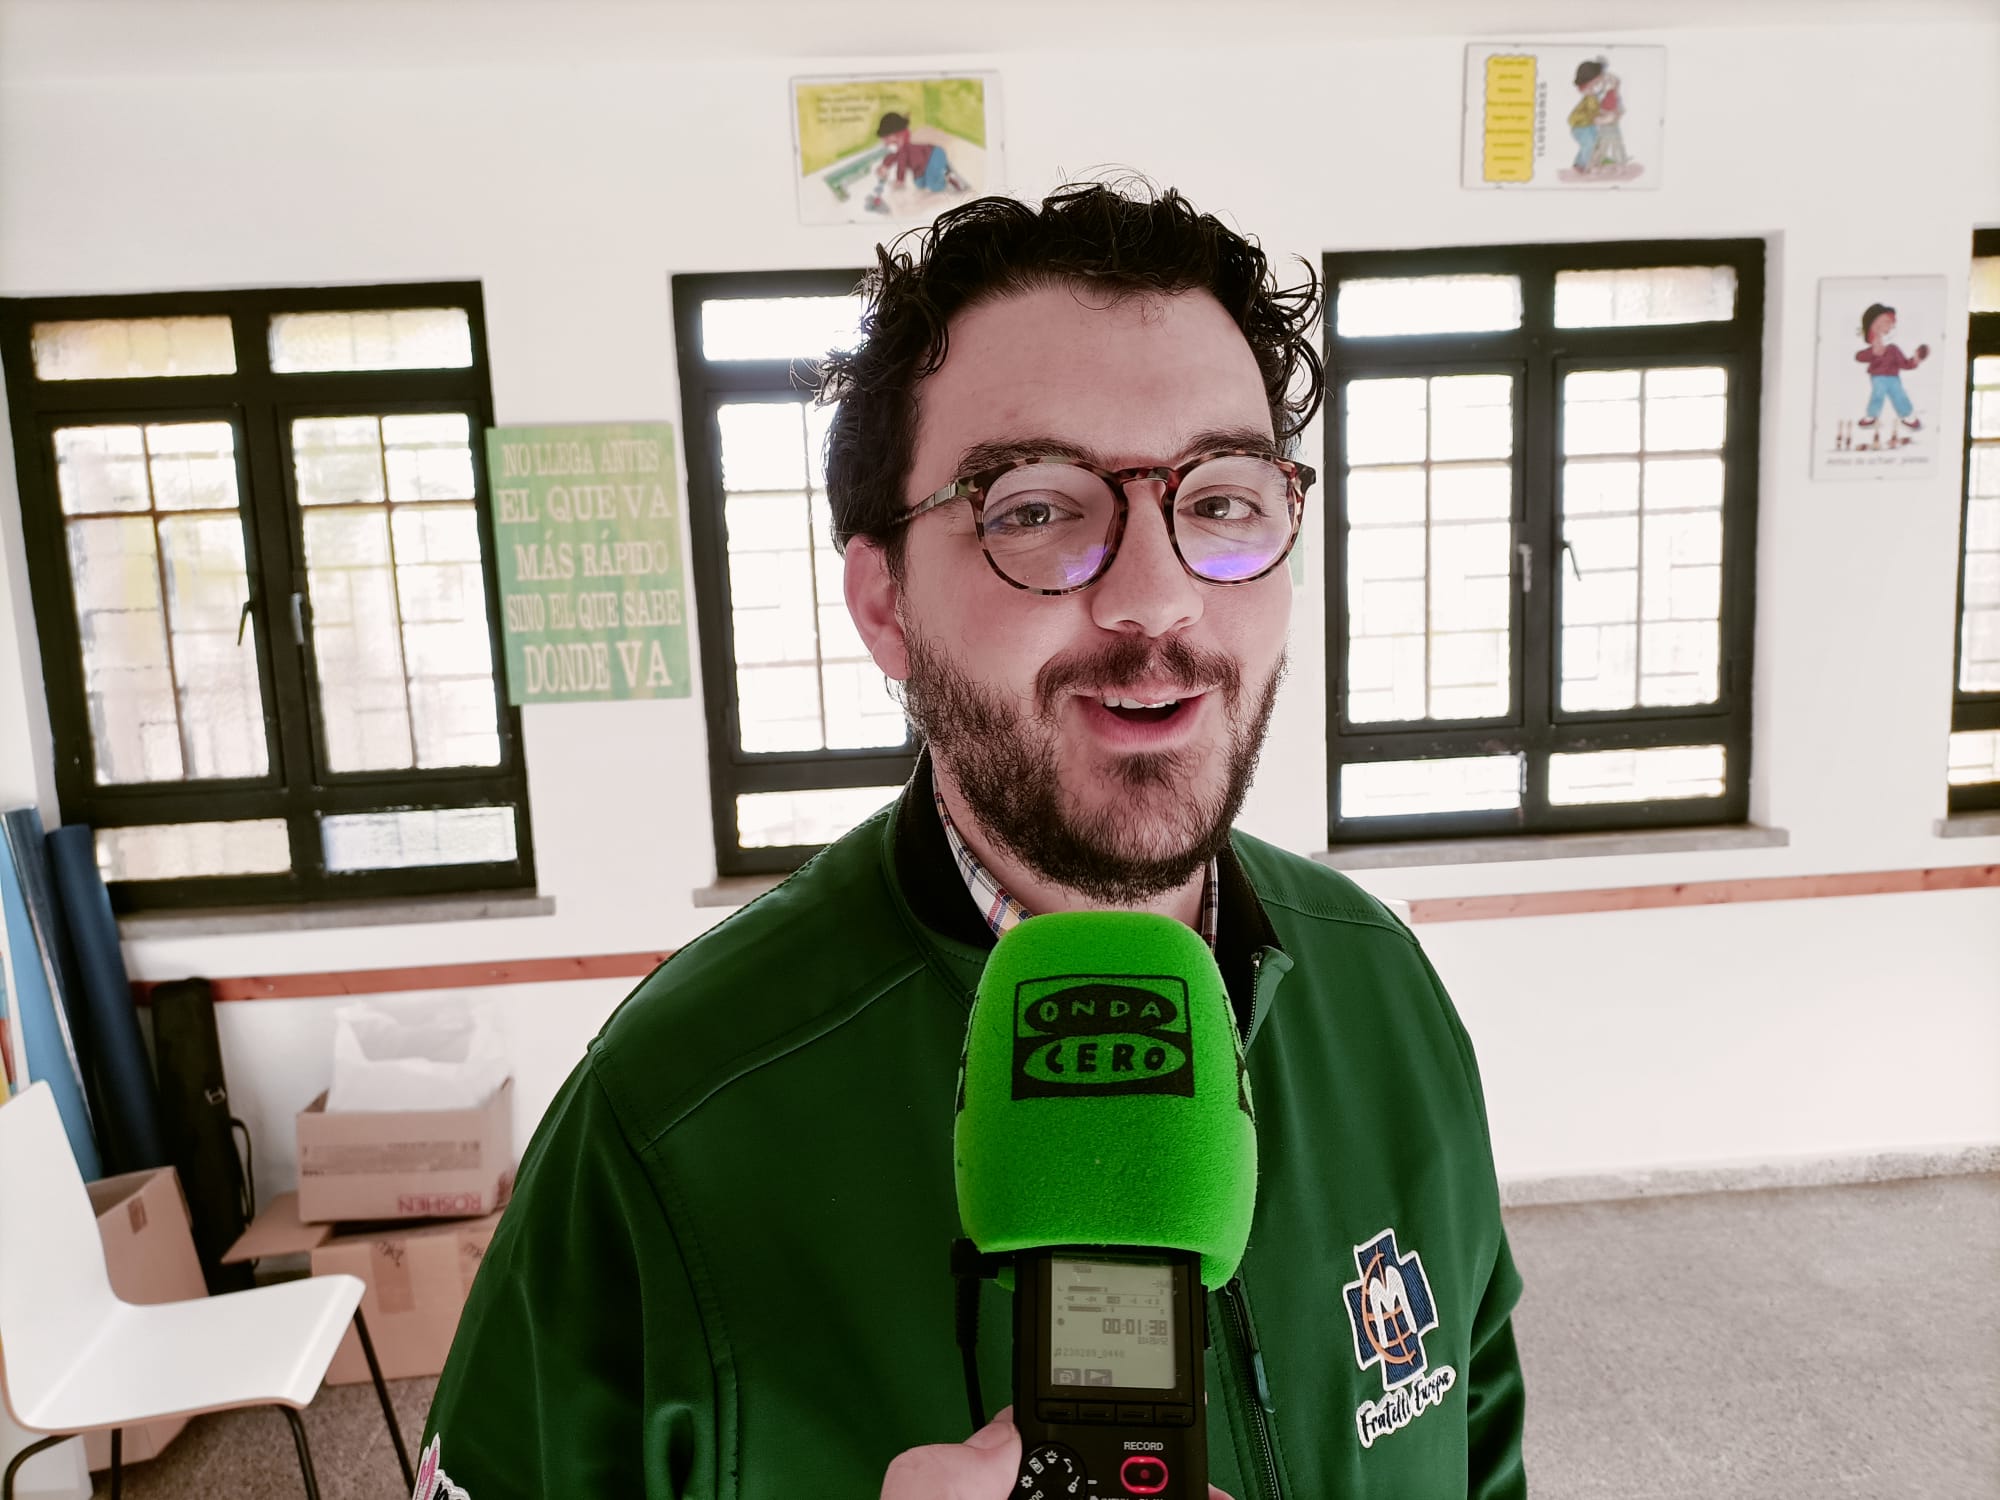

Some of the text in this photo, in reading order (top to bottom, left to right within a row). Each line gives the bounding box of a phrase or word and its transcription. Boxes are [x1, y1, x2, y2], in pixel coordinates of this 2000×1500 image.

[502, 438, 660, 477] NO LLEGA ANTES
[497, 483, 673, 524] EL QUE VA
[514, 528, 670, 581] MÁS RÁPIDO
[506, 588, 682, 632] SINO EL QUE SABE
[523, 639, 673, 694] DONDE VA
[1039, 999, 1162, 1022] ONDA
[1045, 1042, 1167, 1074] CERO
[397, 1191, 483, 1214] ROSHEN
[1102, 1317, 1168, 1337] 00:01:38
[1360, 1392, 1411, 1442] Fratelli
[1123, 1441, 1164, 1452] RECORD
